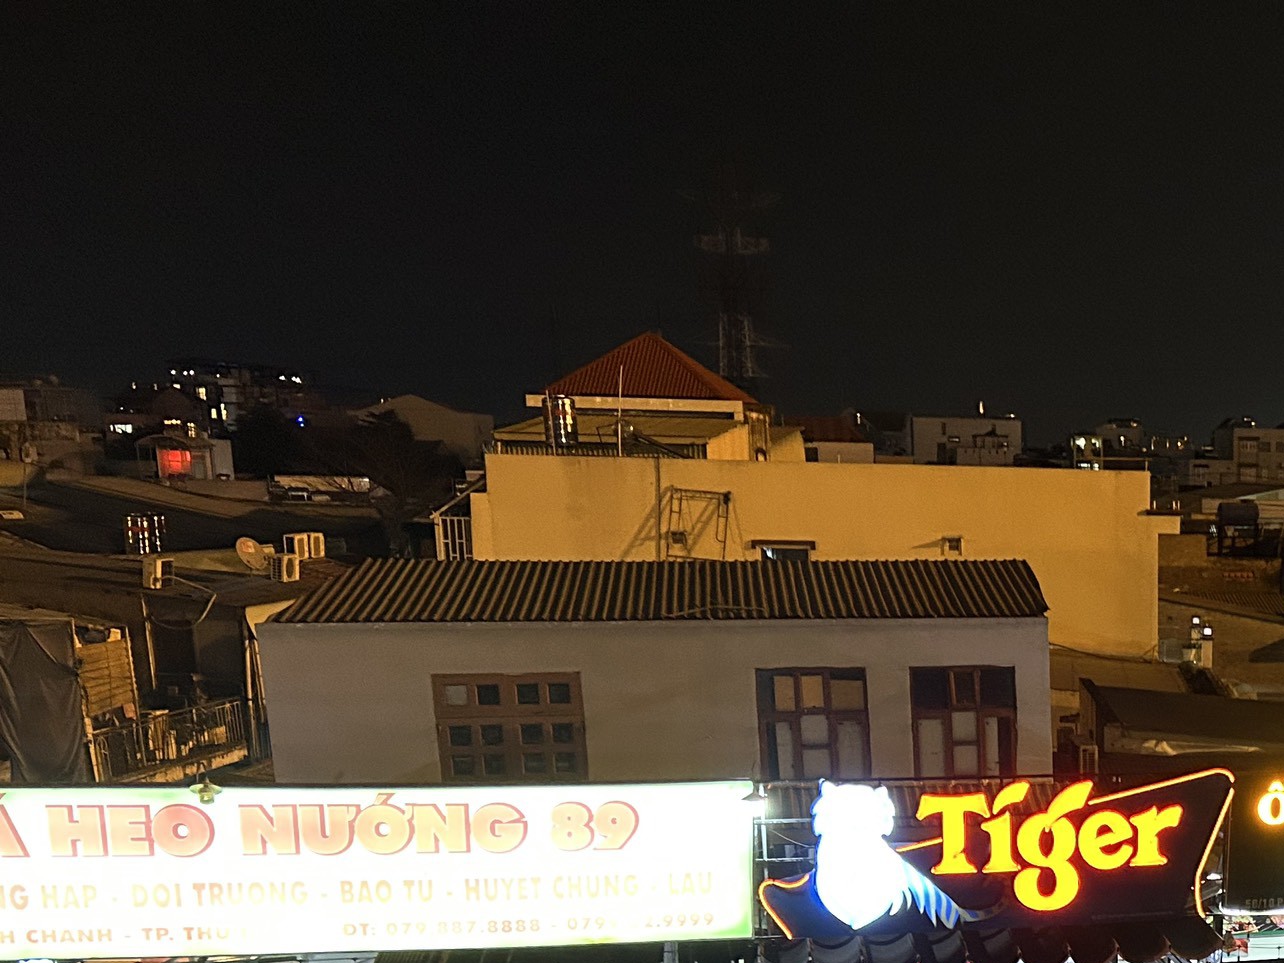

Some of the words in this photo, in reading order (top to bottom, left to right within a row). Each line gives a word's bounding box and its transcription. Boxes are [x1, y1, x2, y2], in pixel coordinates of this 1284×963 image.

[45, 802, 215, 858] HEO
[238, 792, 528, 858] NƯỚNG
[550, 799, 639, 852] 89
[916, 779, 1184, 912] Tiger
[340, 879, 393, 905] BAO
